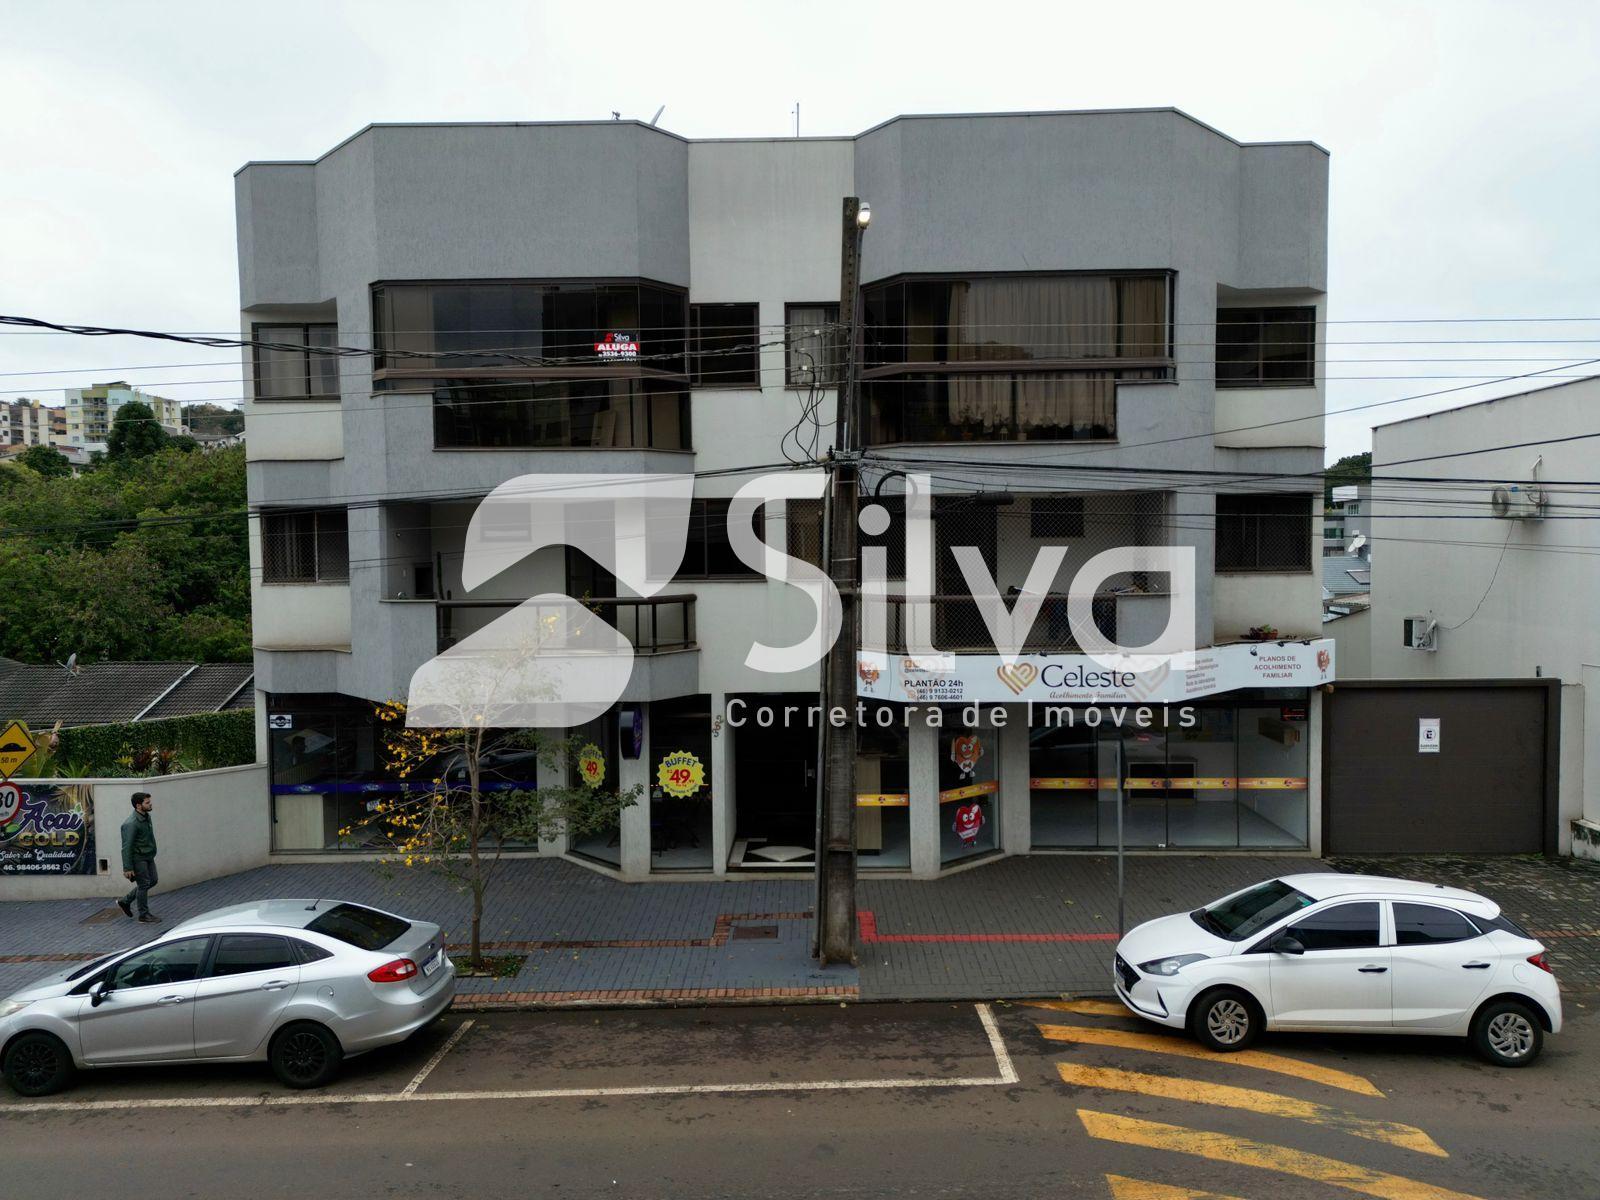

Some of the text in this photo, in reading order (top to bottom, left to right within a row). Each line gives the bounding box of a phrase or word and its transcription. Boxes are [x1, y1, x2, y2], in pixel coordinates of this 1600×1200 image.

[598, 343, 637, 351] ALUGA
[1041, 664, 1136, 688] Celeste
[904, 678, 946, 688] PLANTÃO
[665, 757, 698, 768] BUFFET
[669, 769, 691, 783] 49
[20, 831, 80, 846] GOLD
[23, 850, 33, 858] de
[35, 848, 76, 861] Qualidade
